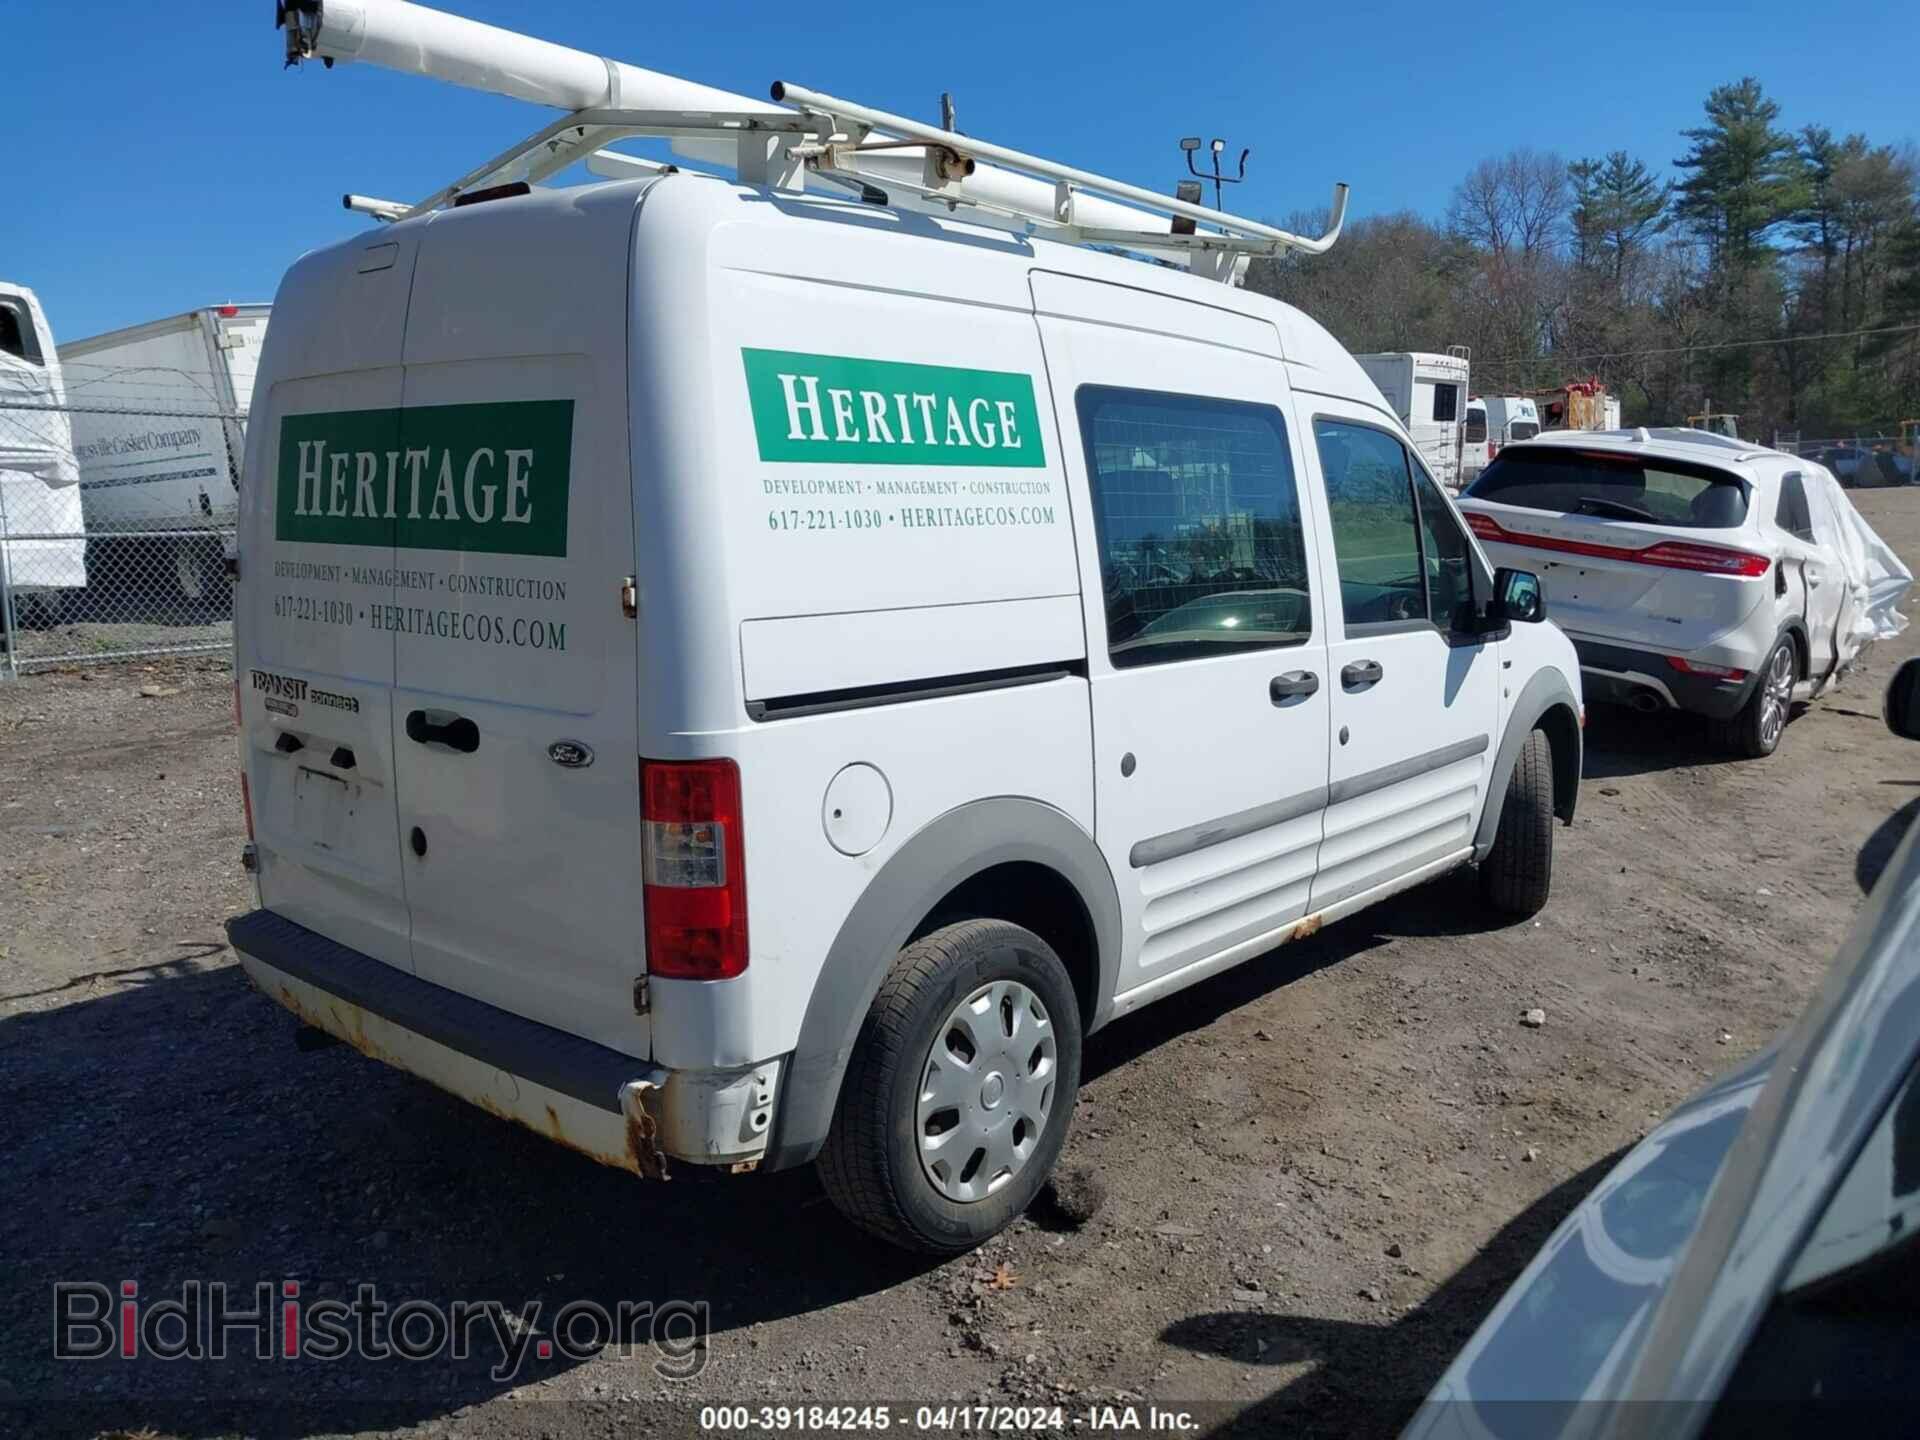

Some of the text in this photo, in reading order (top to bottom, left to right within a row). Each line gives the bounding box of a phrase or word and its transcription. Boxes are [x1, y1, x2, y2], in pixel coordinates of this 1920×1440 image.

[777, 373, 1022, 449] HERITAGE
[149, 428, 201, 452] Company
[294, 440, 534, 524] HERITAGE
[763, 479, 1051, 496] DEVELOPMENT MANAGEMENT CONSTRUCTION
[768, 506, 1055, 530] 617-221-1030 HERITAGECOS.COM
[274, 561, 566, 600] DEVELOPMENT MANAGEMENT CONSTRUCTION
[274, 596, 566, 651] 617-221-1030 HERITAGECOS.COM
[250, 669, 308, 701] TRANSIT
[311, 689, 360, 713] connect
[552, 744, 579, 762] Ford
